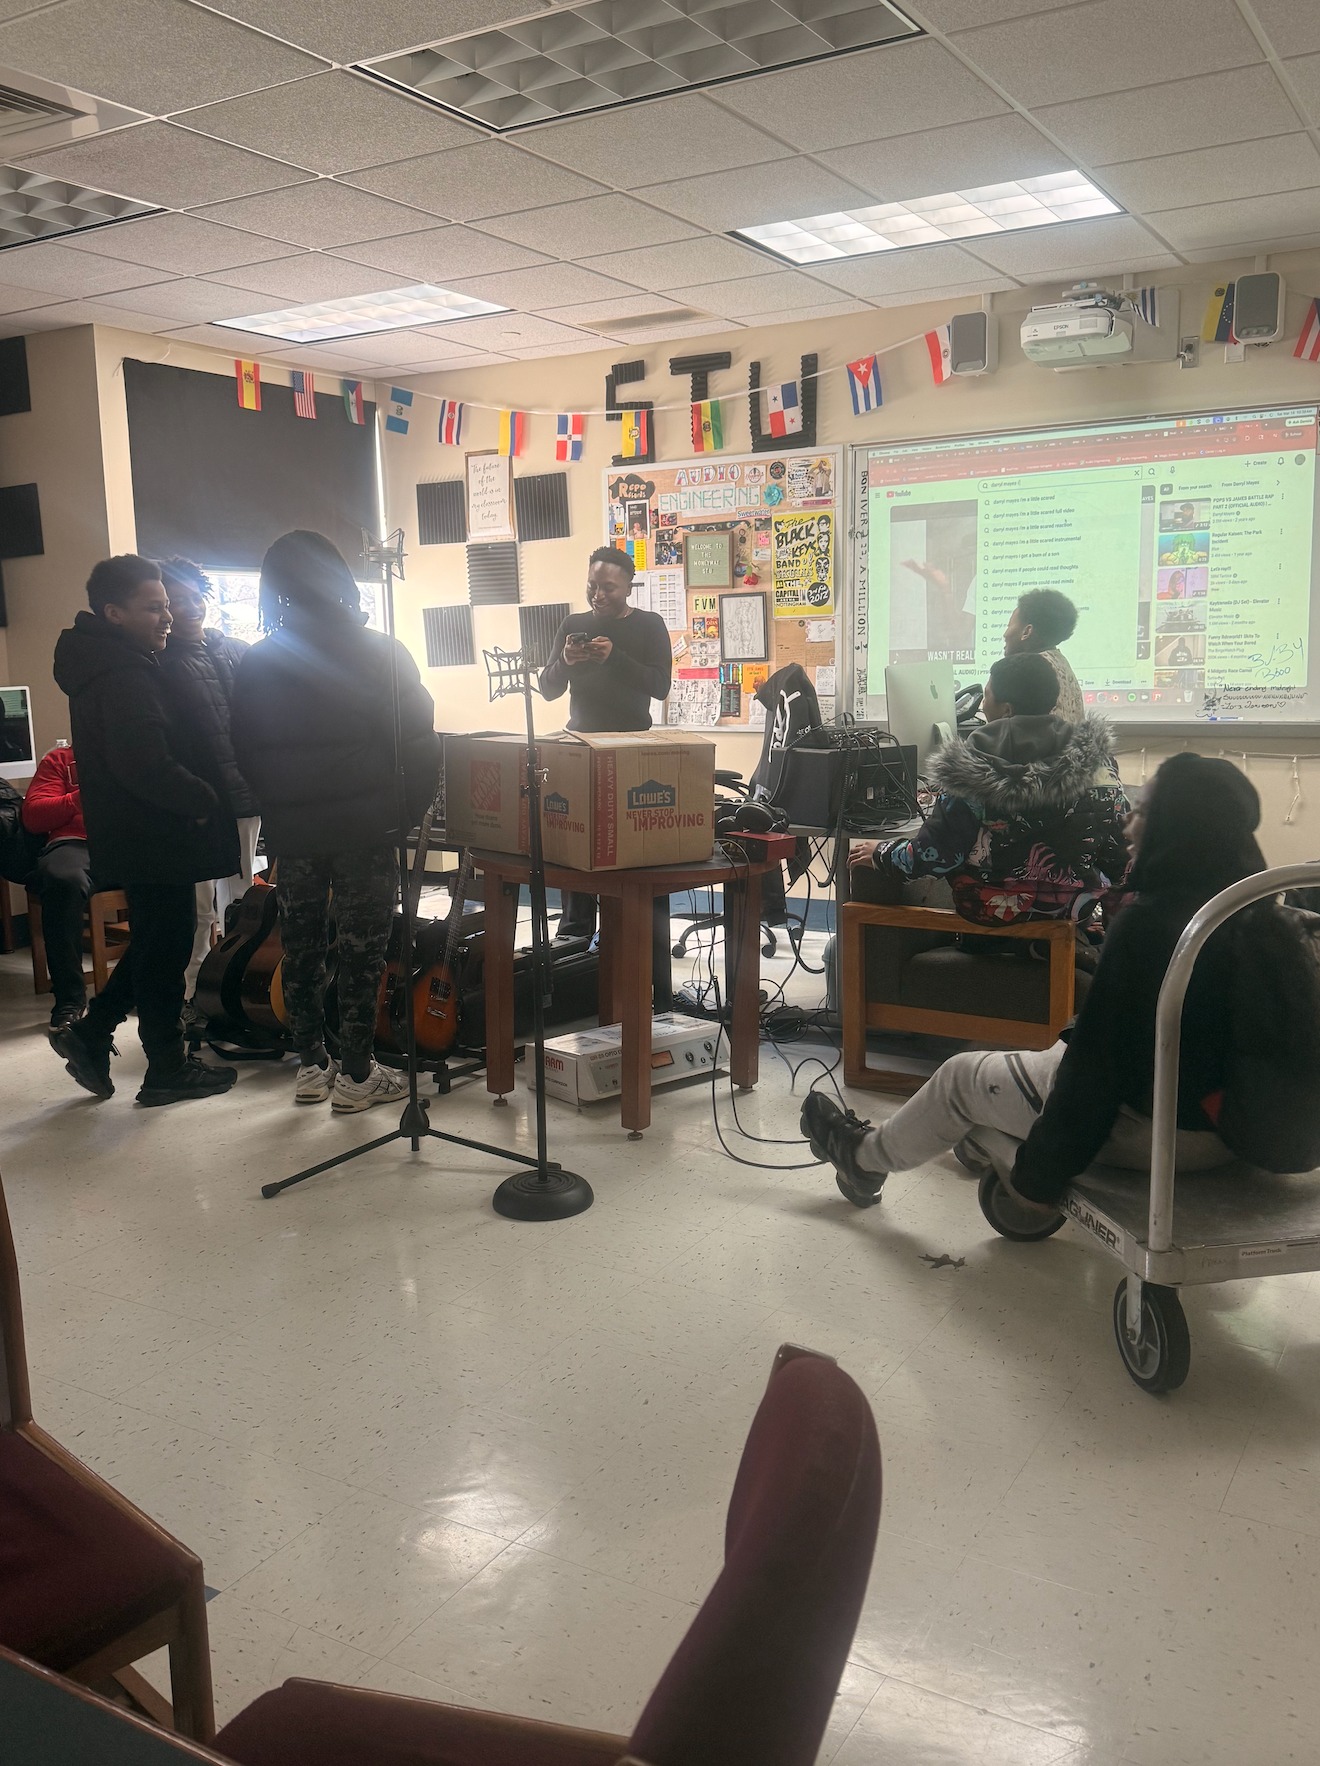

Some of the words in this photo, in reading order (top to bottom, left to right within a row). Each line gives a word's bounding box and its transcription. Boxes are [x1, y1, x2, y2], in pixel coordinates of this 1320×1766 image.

[674, 463, 742, 486] AUDIO
[860, 471, 868, 495] BON
[659, 485, 759, 513] ENGINEERING
[895, 489, 912, 497] YouTube
[737, 508, 770, 518] Sweetwater
[860, 499, 868, 527] IVER
[775, 522, 815, 550] BLACK
[791, 540, 819, 559] KEYS
[776, 559, 801, 569] BAND
[859, 565, 867, 575] A
[775, 589, 800, 598] CAPITAL
[810, 590, 829, 604] 2012
[694, 598, 716, 611] FVM
[858, 579, 867, 636] MILLION
[927, 650, 954, 661] WASN'T
[1244, 684, 1266, 693] ending
[633, 790, 672, 807] LOWE'S
[626, 810, 653, 820] NEVER
[654, 808, 675, 818] STOP
[546, 817, 585, 833] IMPROVING
[633, 813, 705, 832] IMPROVING
[545, 1055, 564, 1071] ARM
